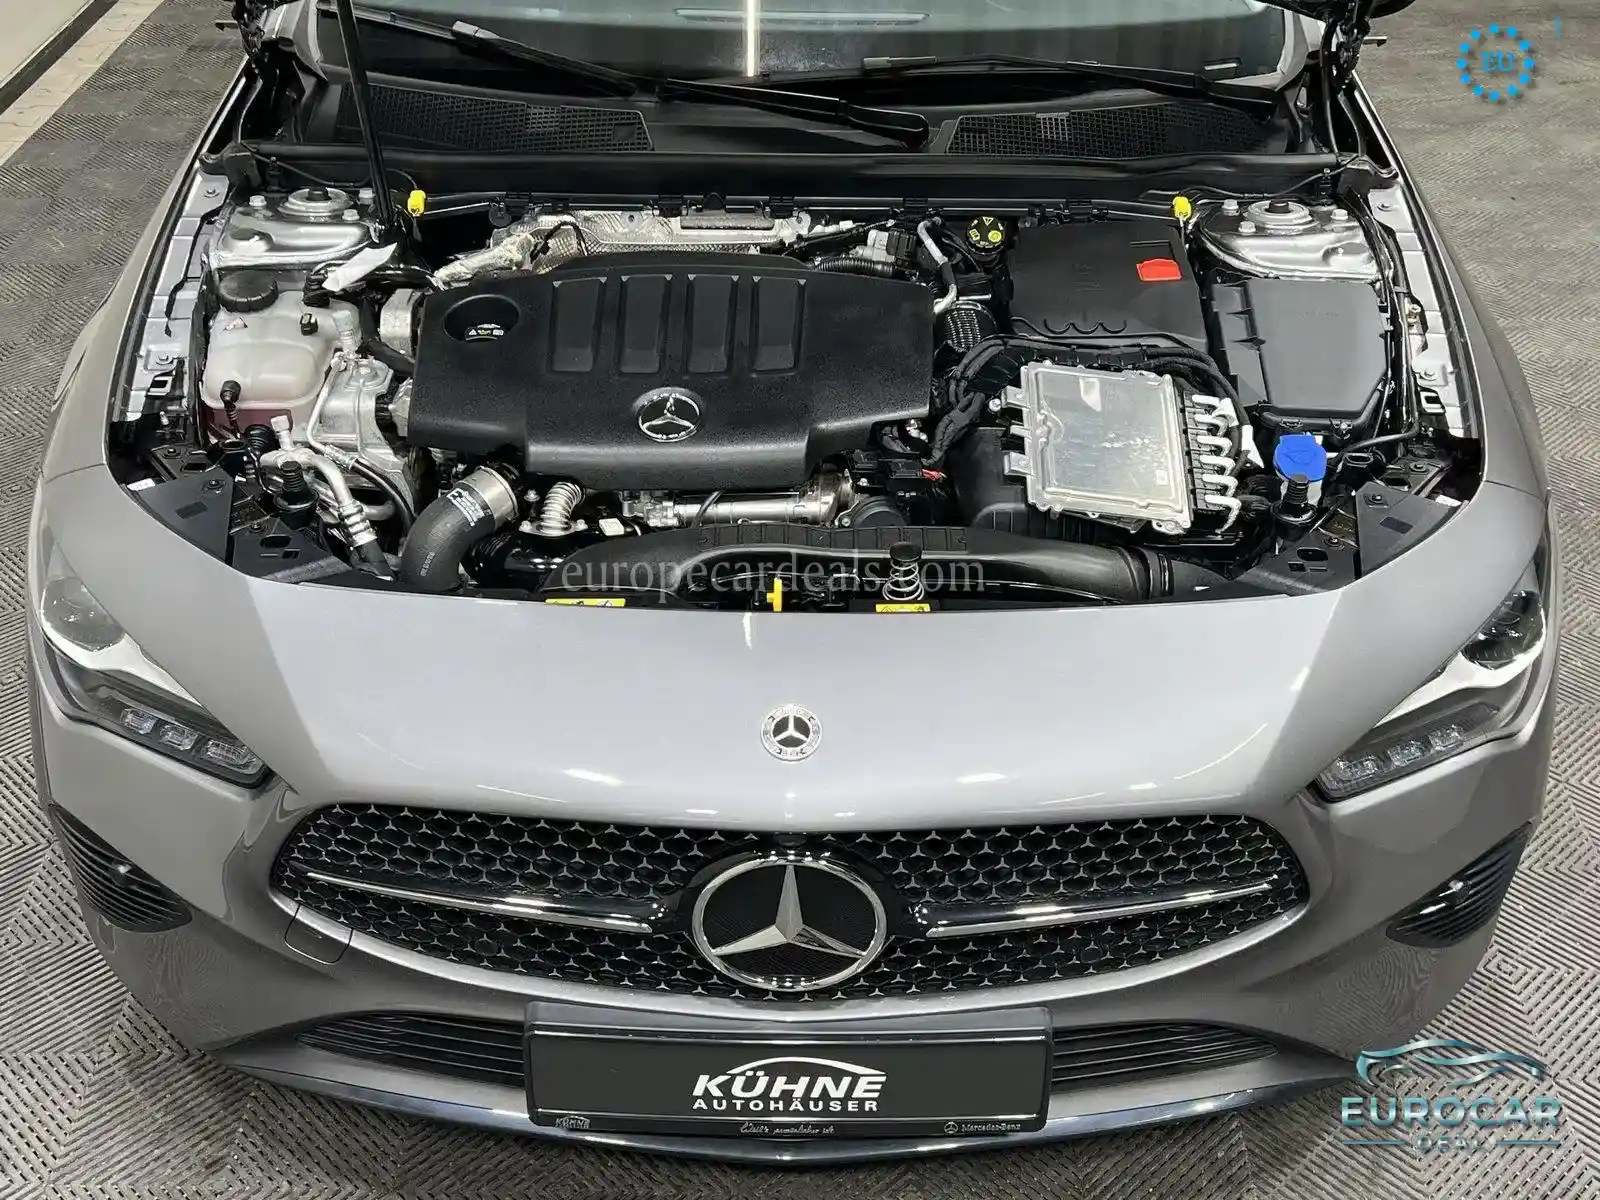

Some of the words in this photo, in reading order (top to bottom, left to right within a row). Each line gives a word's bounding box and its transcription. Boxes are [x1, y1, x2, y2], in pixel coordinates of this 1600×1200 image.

[692, 1070, 887, 1098] KÜHNE
[692, 1098, 878, 1112] AUTOHÄUSER
[961, 1123, 1021, 1132] Mercedes-Benz
